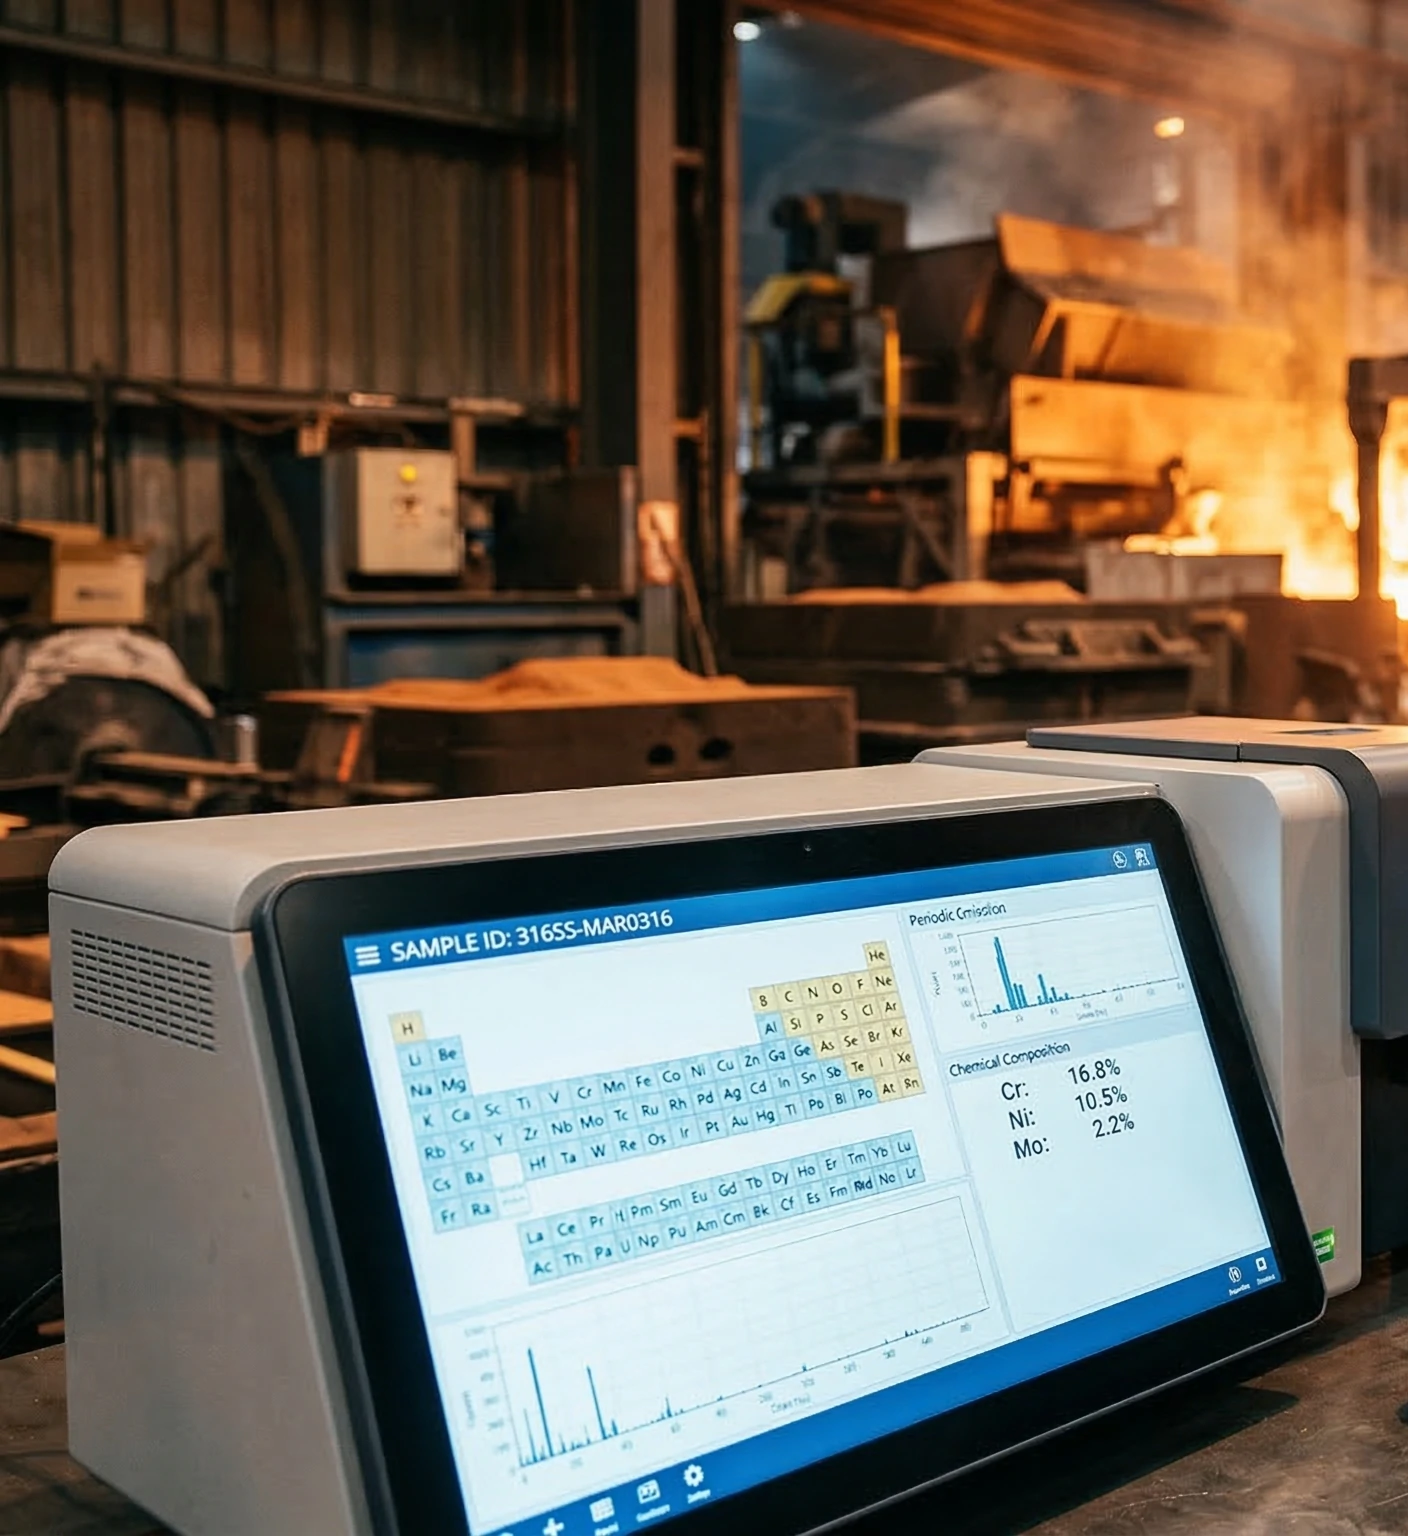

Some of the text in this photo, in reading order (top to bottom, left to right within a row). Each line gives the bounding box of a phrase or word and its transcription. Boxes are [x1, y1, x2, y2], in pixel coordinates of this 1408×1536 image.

[391, 909, 673, 962] SAMPLE ID: 316SS-MAR0316
[909, 908, 955, 926] Periodic
[869, 950, 885, 961] He
[785, 991, 793, 1002] C
[808, 987, 818, 998] N
[832, 983, 842, 994] O
[857, 979, 863, 989] F
[875, 976, 892, 986] Ne
[402, 1023, 413, 1034] H
[765, 1022, 777, 1034] Al
[817, 1014, 823, 1023] P
[841, 1009, 848, 1020] S
[885, 1002, 896, 1012] Ar
[438, 1048, 456, 1061] Be
[549, 1092, 558, 1103] V
[578, 1087, 591, 1099] Cr
[604, 1081, 625, 1093] Mn
[636, 1076, 650, 1087] Fe
[662, 1070, 681, 1083] Co
[717, 1060, 734, 1072] Cu
[745, 1055, 760, 1067] Zn
[821, 1041, 834, 1052] As
[844, 1036, 858, 1047] Se
[868, 1031, 880, 1042] Br
[891, 1028, 902, 1037] Kr
[410, 1078, 466, 1097] Na Mg
[1001, 1059, 1121, 1100] Cr: 16.8%
[425, 1147, 445, 1160] Rb
[551, 1121, 572, 1134] Nb
[580, 1116, 603, 1128] Mo
[614, 1110, 628, 1121] Tc
[641, 1105, 658, 1116] Ru
[669, 1098, 687, 1110] Rh
[697, 1091, 714, 1105] Pd
[724, 1088, 741, 1102] Ag
[750, 1080, 767, 1094] Cd
[778, 1077, 790, 1088] In
[801, 1072, 816, 1084] Sn
[851, 1061, 864, 1072] Te
[897, 1052, 910, 1063] Xe
[1009, 1086, 1127, 1130] Ni: 10.5%
[433, 1178, 451, 1192] Cs
[465, 1172, 484, 1185] Ba
[561, 1152, 576, 1163] Ta
[591, 1145, 605, 1158] W
[619, 1140, 636, 1151] Re
[648, 1134, 666, 1145] Os
[732, 1116, 748, 1127] Au
[756, 1110, 775, 1124] Hg
[809, 1099, 824, 1110] Po
[858, 1089, 872, 1100] Po
[904, 1078, 919, 1089] Sn
[1014, 1113, 1135, 1159] Mo: 2.2%
[472, 1204, 491, 1215] Ra
[527, 1232, 544, 1244] La
[557, 1223, 575, 1236] Ce
[590, 1216, 603, 1227] Pr
[615, 1210, 625, 1222] H
[631, 1206, 653, 1218] Pm
[660, 1198, 681, 1211] Sm
[692, 1191, 707, 1203] Eu
[718, 1182, 737, 1197] Gd
[745, 1177, 762, 1189] Tb
[772, 1172, 788, 1185] Dy
[798, 1166, 815, 1177] Ho
[825, 1159, 836, 1170] Er
[847, 1153, 866, 1164] Tm
[898, 1142, 911, 1152] Lu
[534, 1262, 551, 1275] Ac
[620, 1240, 630, 1254] U
[638, 1235, 658, 1248] Np
[669, 1227, 686, 1239] Pu
[697, 1220, 718, 1232] Am
[724, 1213, 745, 1225] Cm
[753, 1204, 769, 1218] Bk
[781, 1196, 793, 1211] Cf
[807, 1193, 820, 1204] Es
[830, 1186, 847, 1197] Fm
[906, 1168, 916, 1179] Lr
